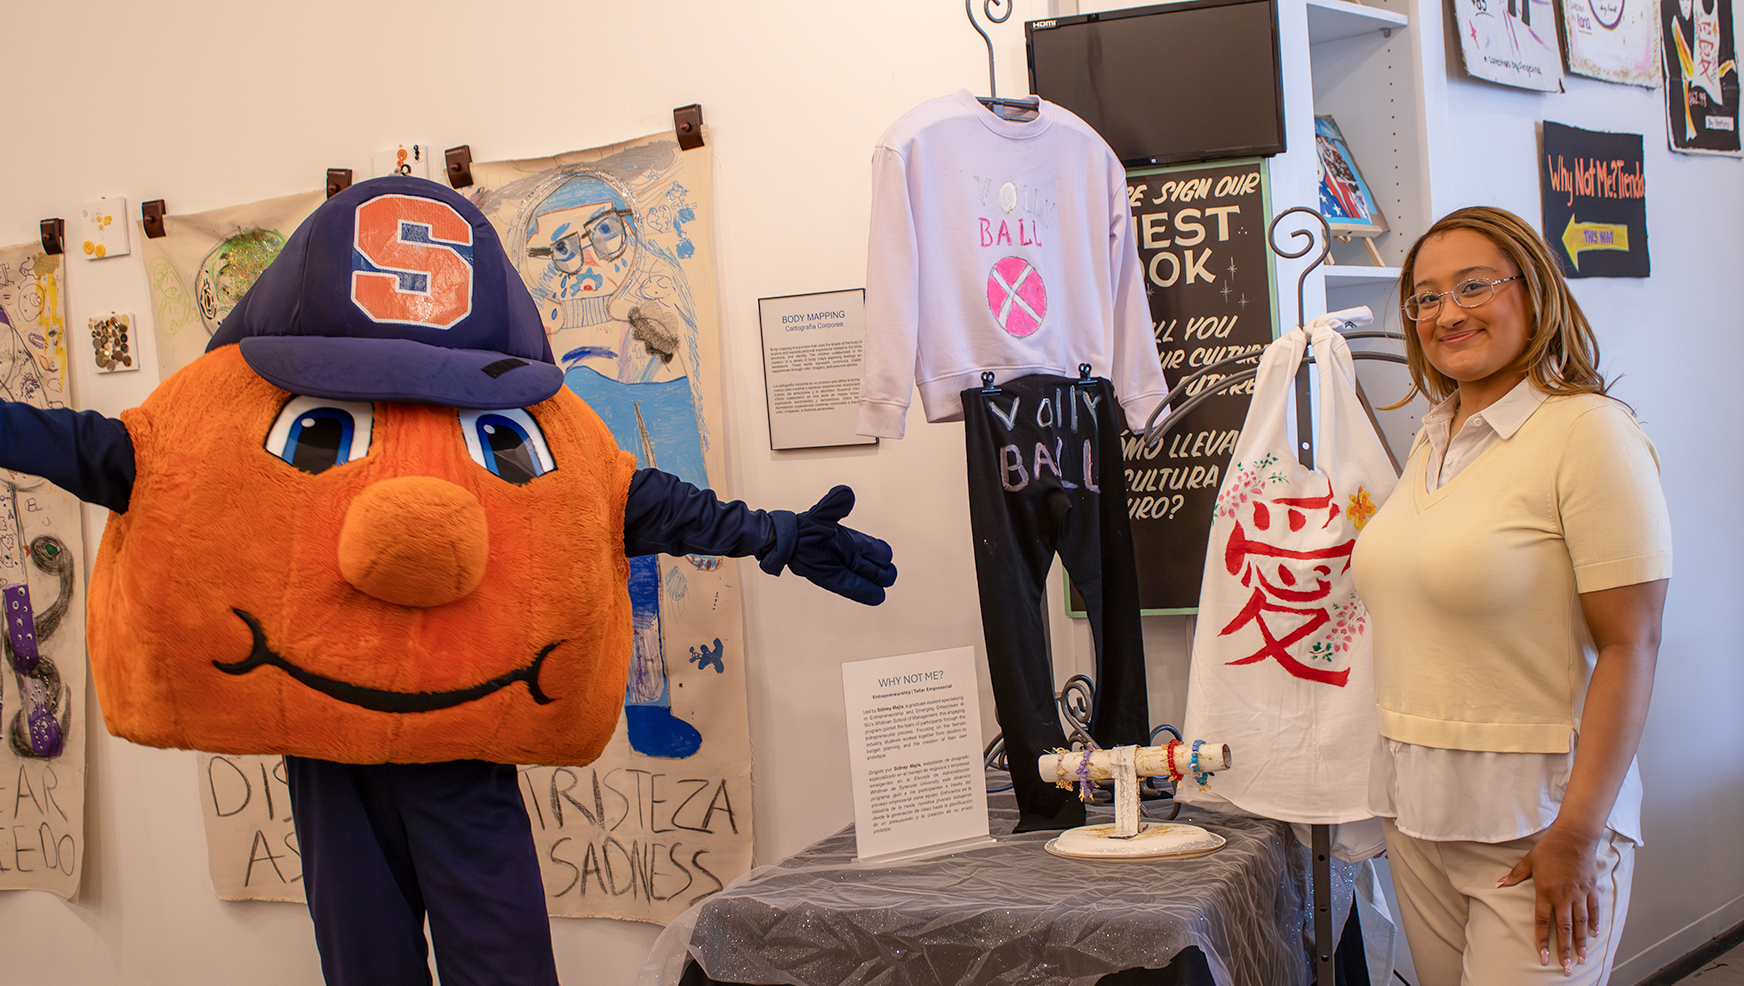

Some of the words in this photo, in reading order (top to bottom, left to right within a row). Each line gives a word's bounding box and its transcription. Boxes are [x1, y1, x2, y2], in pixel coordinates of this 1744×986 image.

[1032, 20, 1057, 28] HDMI
[1152, 177, 1213, 205] SIGN
[1214, 172, 1260, 198] OUR
[1548, 154, 1574, 207] Why
[1574, 157, 1596, 197] Not
[1596, 160, 1617, 199] Me?
[978, 217, 1042, 247] BALL
[1583, 229, 1598, 244] THIS
[1599, 230, 1614, 245] WAY
[351, 193, 474, 331] S
[1139, 247, 1217, 288] OK
[782, 314, 805, 324] BODY
[807, 310, 845, 322] MAPPING
[1184, 315, 1239, 341] YOU
[1000, 436, 1101, 494] BALL
[878, 676, 901, 687] WHY
[904, 673, 923, 684] NOT
[925, 670, 944, 681] ME?
[0, 763, 68, 823] AR
[518, 765, 739, 834] TRISTEZA
[0, 822, 75, 877] EDO
[550, 836, 724, 907] SADNESS
